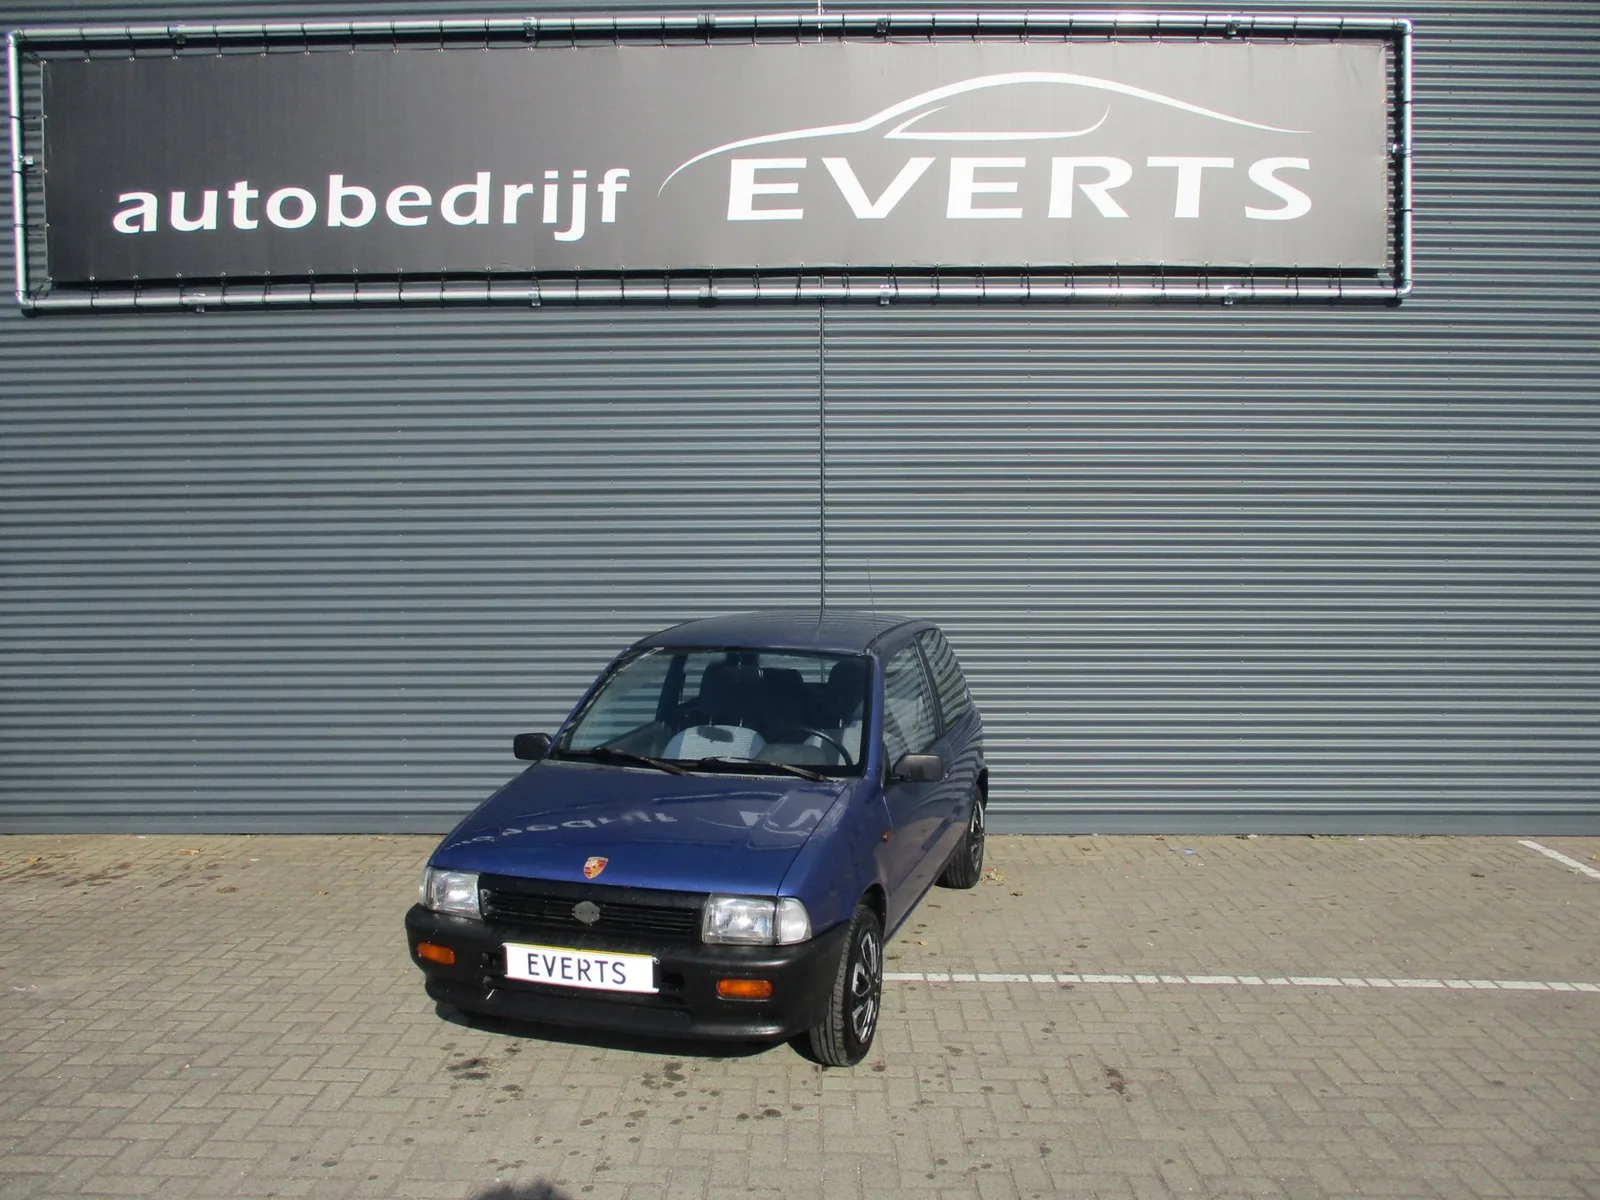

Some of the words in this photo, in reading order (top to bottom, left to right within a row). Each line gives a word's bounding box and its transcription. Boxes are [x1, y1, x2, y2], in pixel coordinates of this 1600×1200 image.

[112, 168, 630, 242] autobedrijf
[726, 156, 1313, 221] EVERTS
[527, 952, 627, 985] EVERTS
